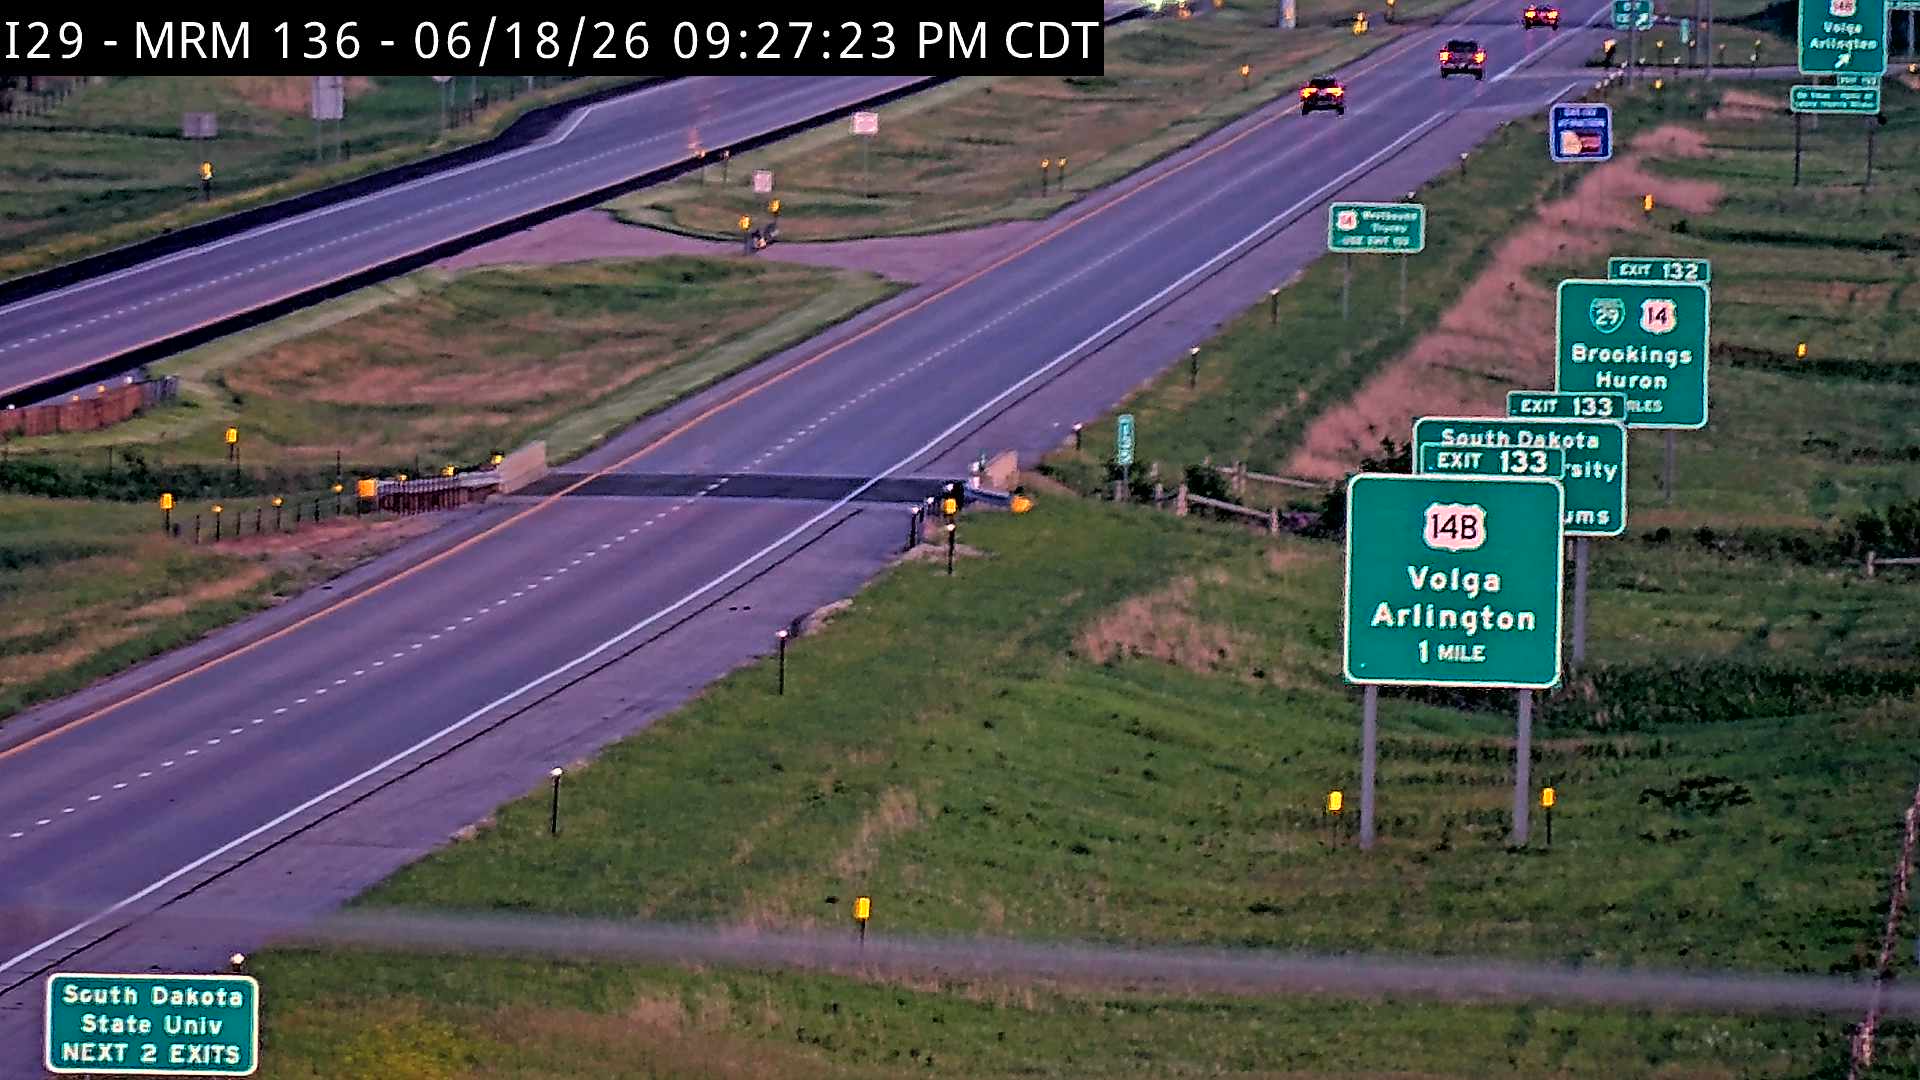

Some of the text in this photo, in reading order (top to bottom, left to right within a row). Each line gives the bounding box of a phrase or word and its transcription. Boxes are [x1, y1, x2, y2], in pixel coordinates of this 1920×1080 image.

[1619, 263, 1698, 280] EXIT 132
[1648, 306, 1668, 325] 14
[1571, 342, 1692, 369] Brookings
[1596, 370, 1668, 389] Huron
[1520, 397, 1613, 416] EXIT 133
[1441, 428, 1599, 449] South Dakota
[1437, 450, 1548, 474] EXIT 133
[1432, 514, 1478, 539] 14B
[1407, 565, 1502, 599] Volga
[1370, 601, 1537, 637] Arlington
[1418, 640, 1487, 664] 1 MILE
[63, 984, 244, 1007] South Dakota
[80, 1013, 224, 1036] State Univ
[61, 1042, 240, 1066] NEXT 2 EXITS
